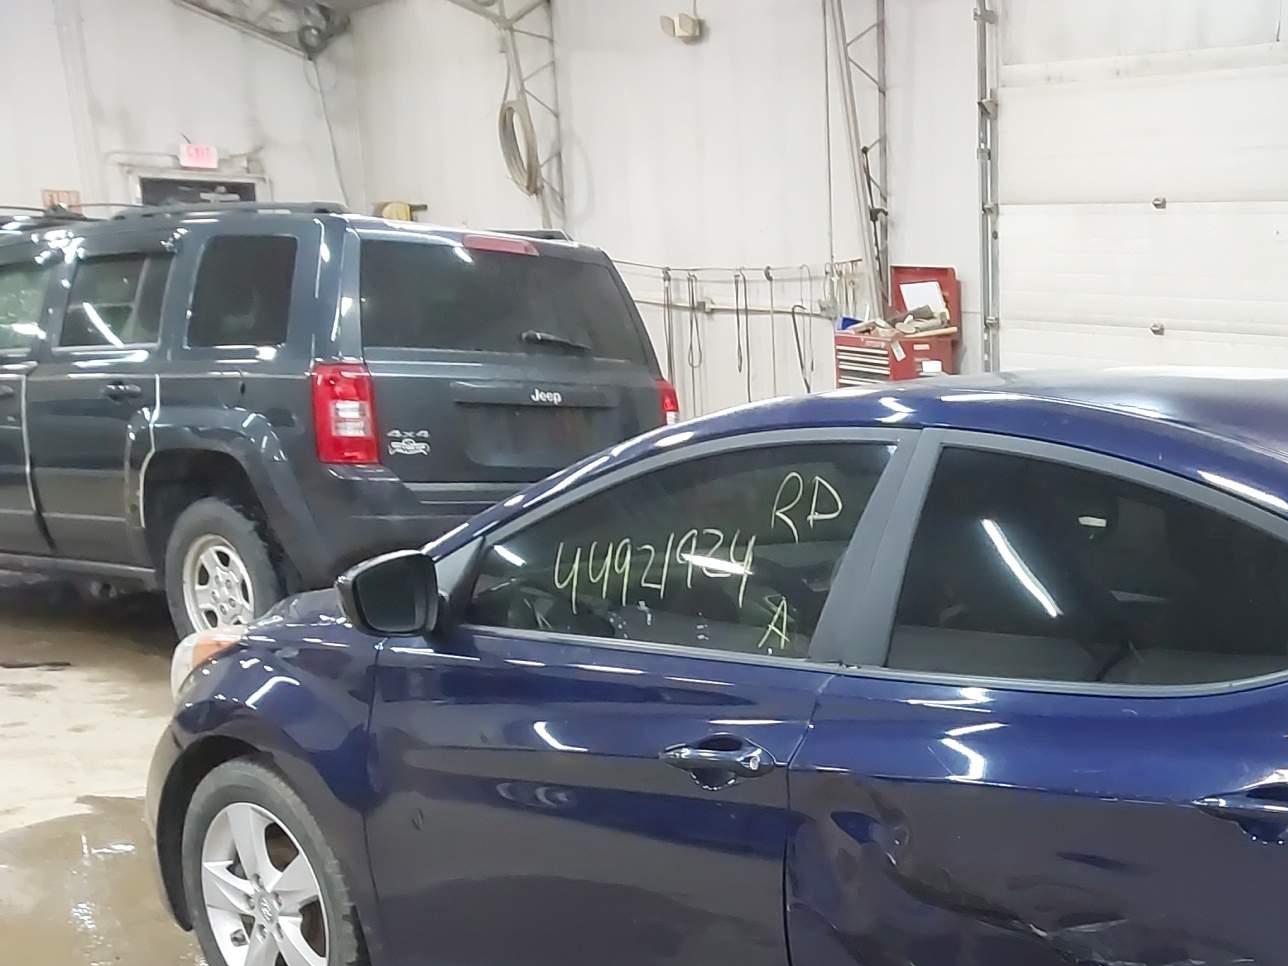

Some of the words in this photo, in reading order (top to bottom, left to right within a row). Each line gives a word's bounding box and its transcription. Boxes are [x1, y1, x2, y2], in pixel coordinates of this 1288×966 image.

[530, 389, 562, 405] Jeep
[386, 430, 430, 438] 4x4
[554, 528, 757, 616] 44921924
